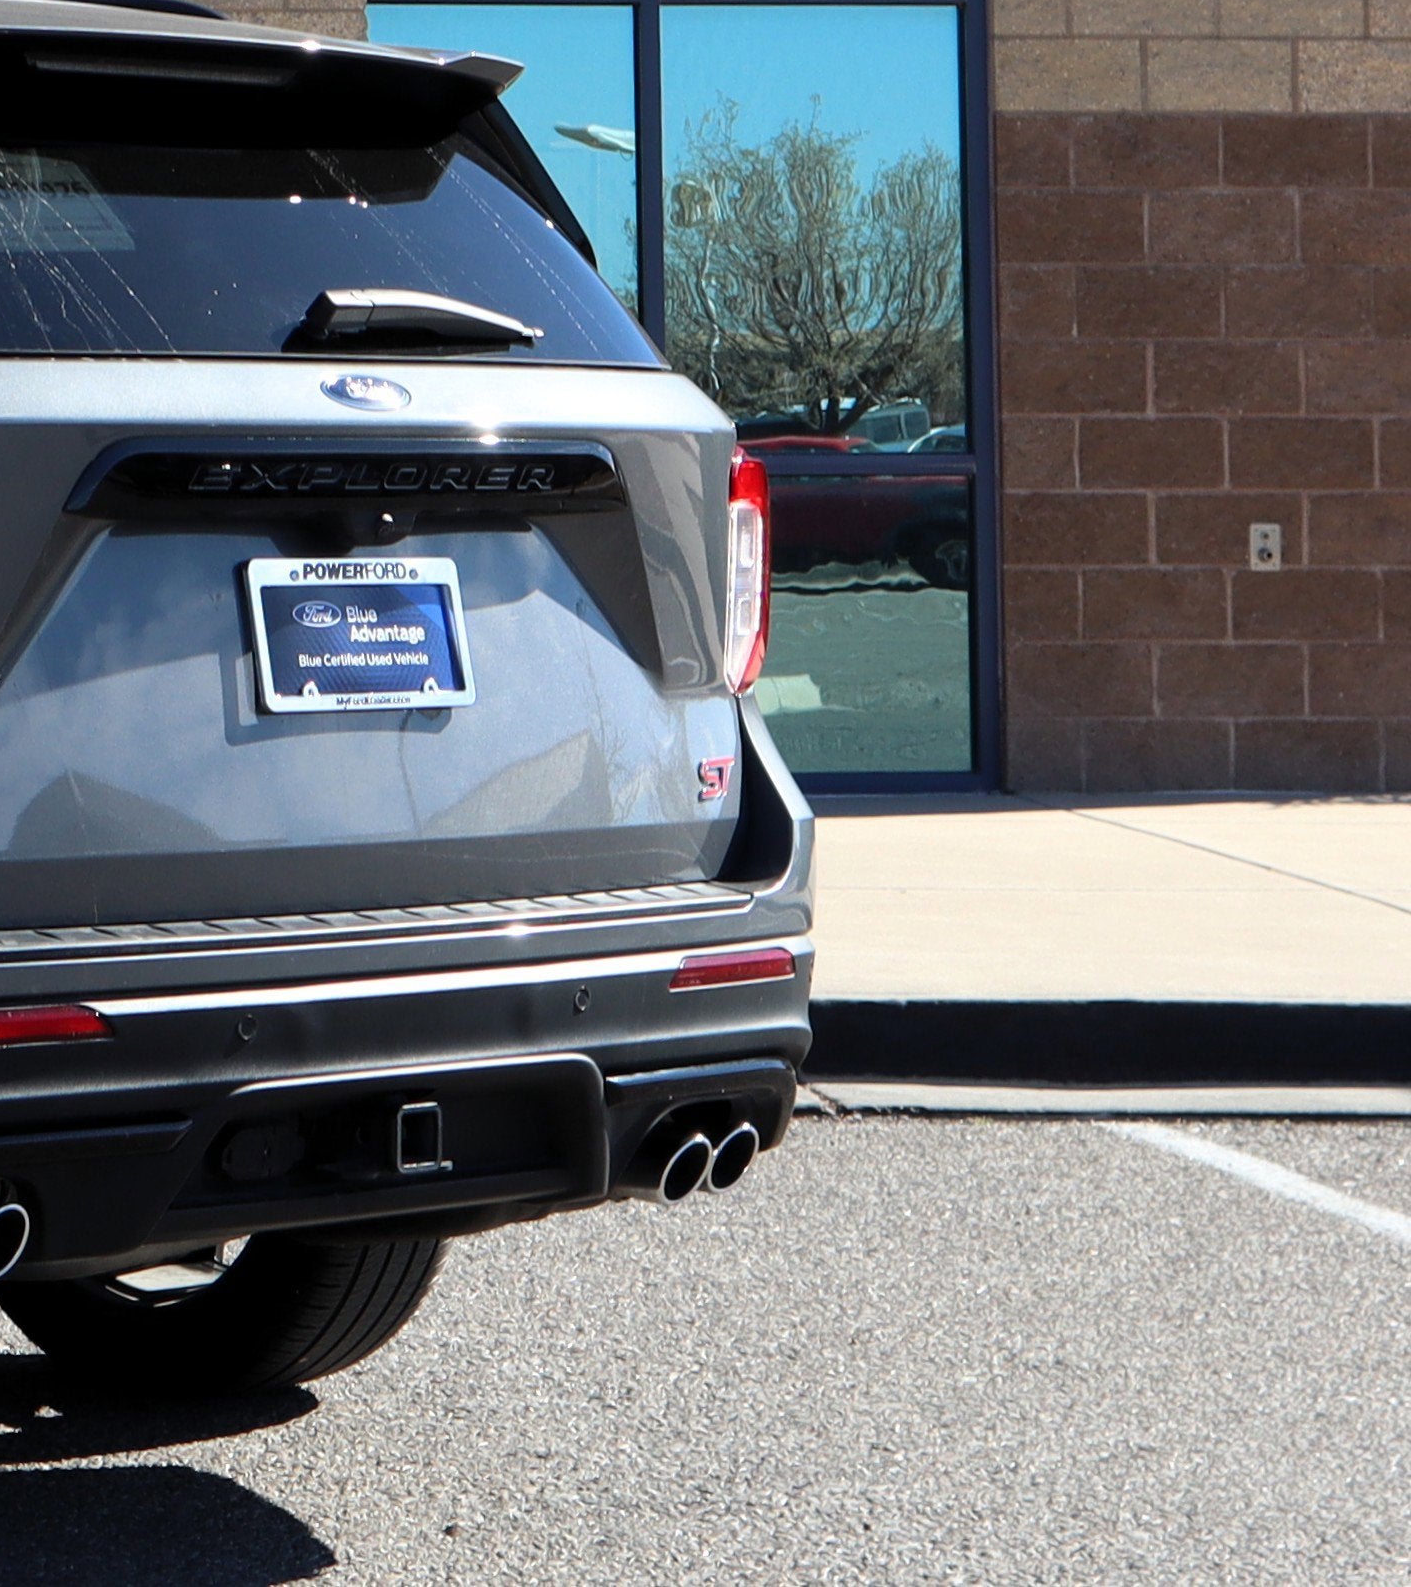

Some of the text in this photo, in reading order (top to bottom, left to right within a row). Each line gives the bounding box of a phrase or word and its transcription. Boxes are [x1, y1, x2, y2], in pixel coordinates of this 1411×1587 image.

[188, 461, 556, 492] EXPLORER
[302, 563, 407, 581] POWERFORD
[302, 604, 334, 624] Ford
[345, 606, 378, 624] Blue
[350, 624, 426, 645] Advantage
[298, 651, 429, 668] Blue Certified Used Vehicle
[699, 757, 736, 800] ST
